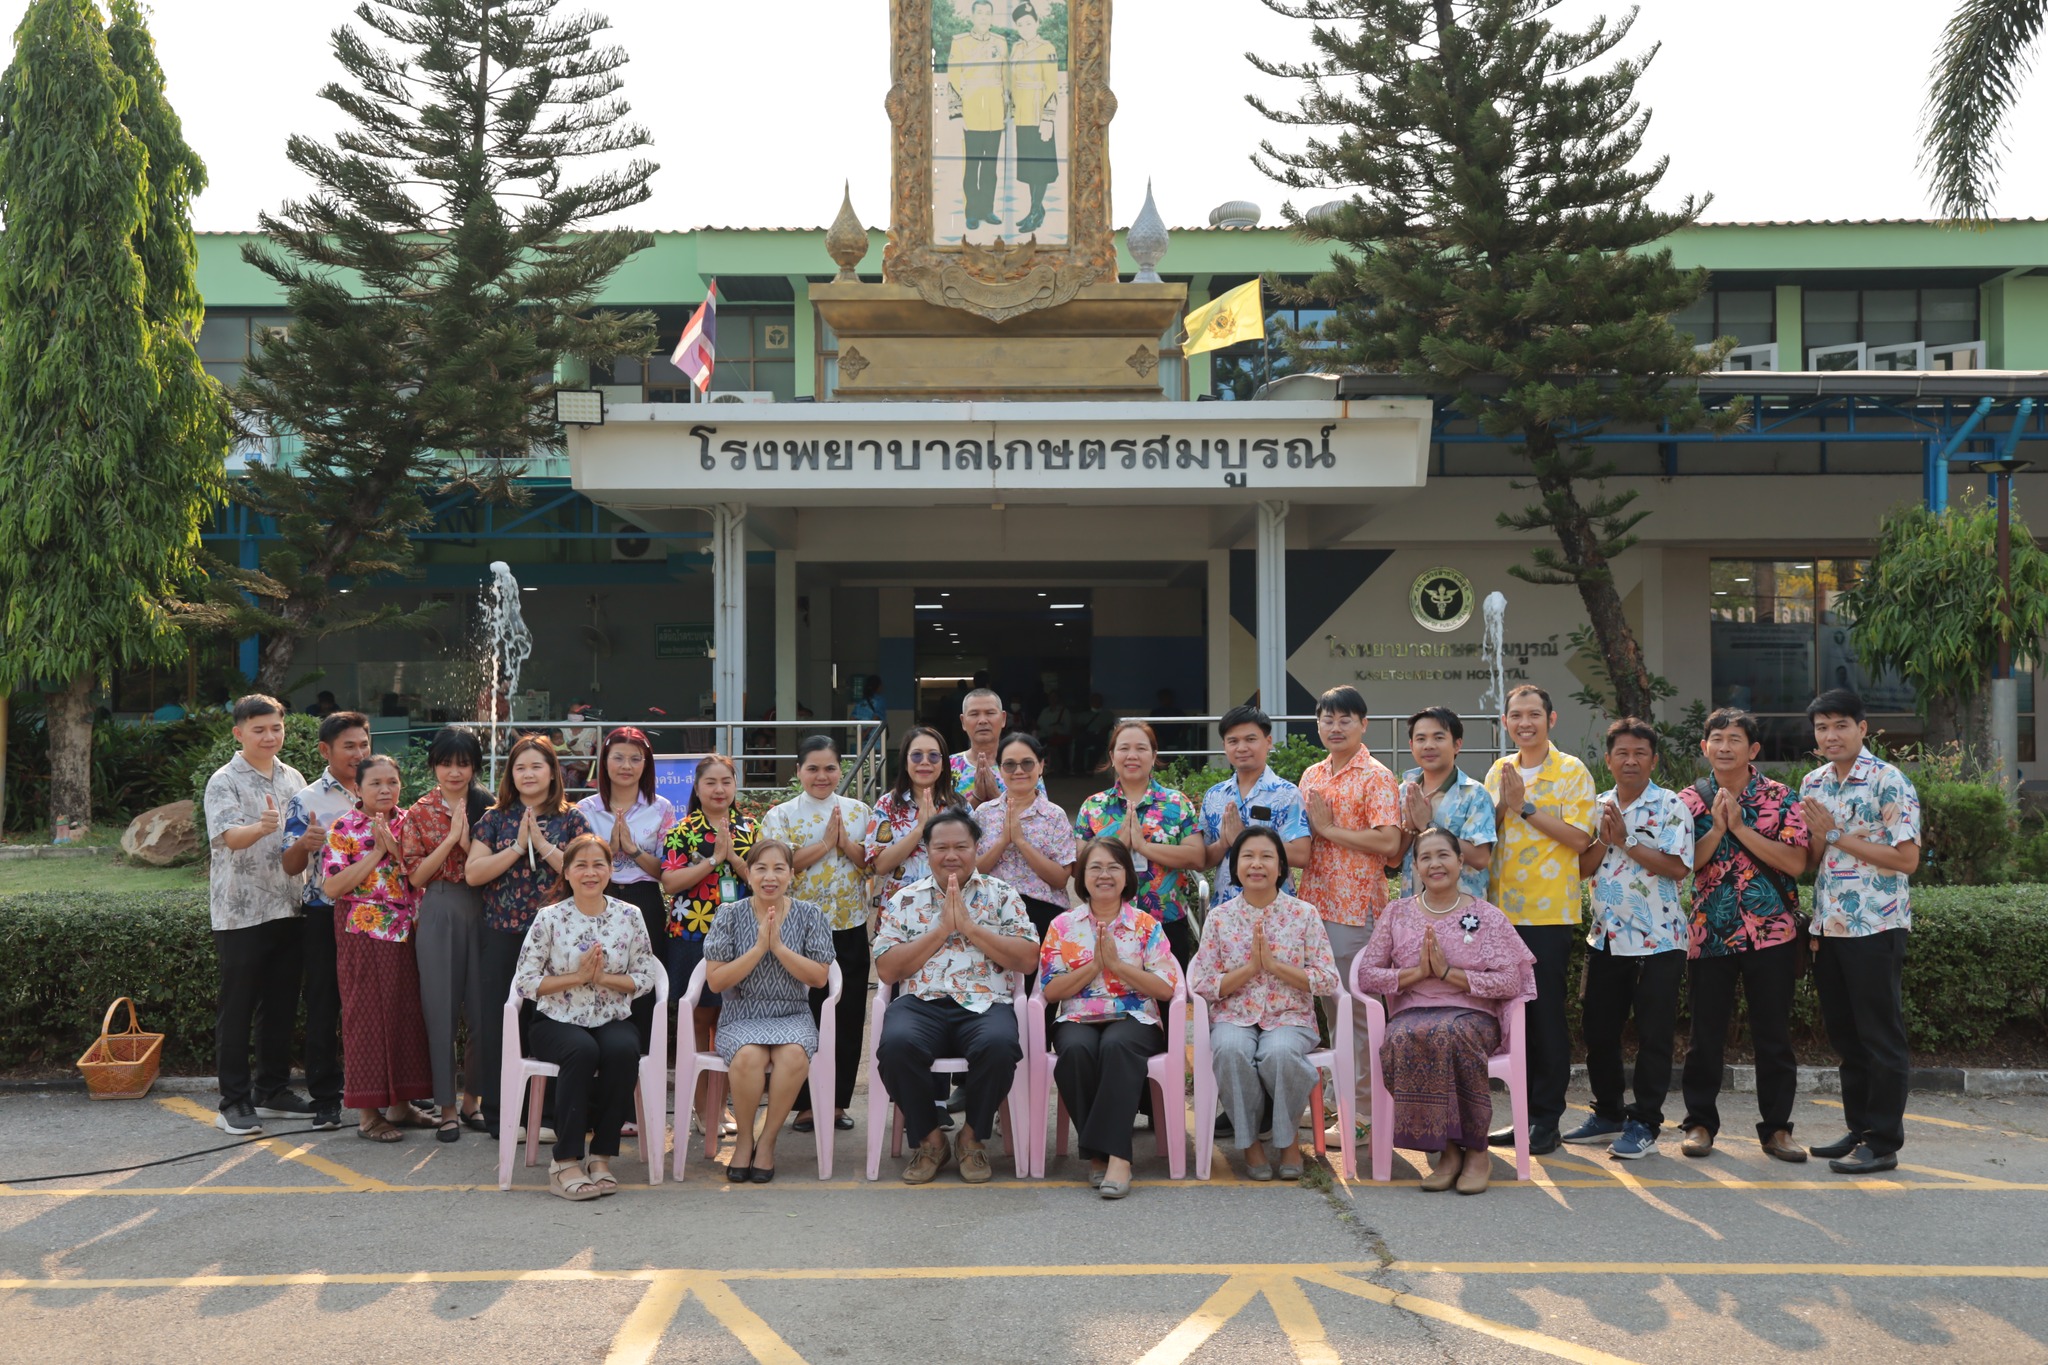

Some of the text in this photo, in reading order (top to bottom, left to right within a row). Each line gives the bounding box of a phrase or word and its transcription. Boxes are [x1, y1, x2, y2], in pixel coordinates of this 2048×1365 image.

[689, 424, 1337, 488] โรงพยาบาลเกษตรสมบูรณ์
[1325, 633, 1559, 665] โรงพยาบาลเกษตรมบูรณ์
[1355, 669, 1462, 681] KASETSOMBOON
